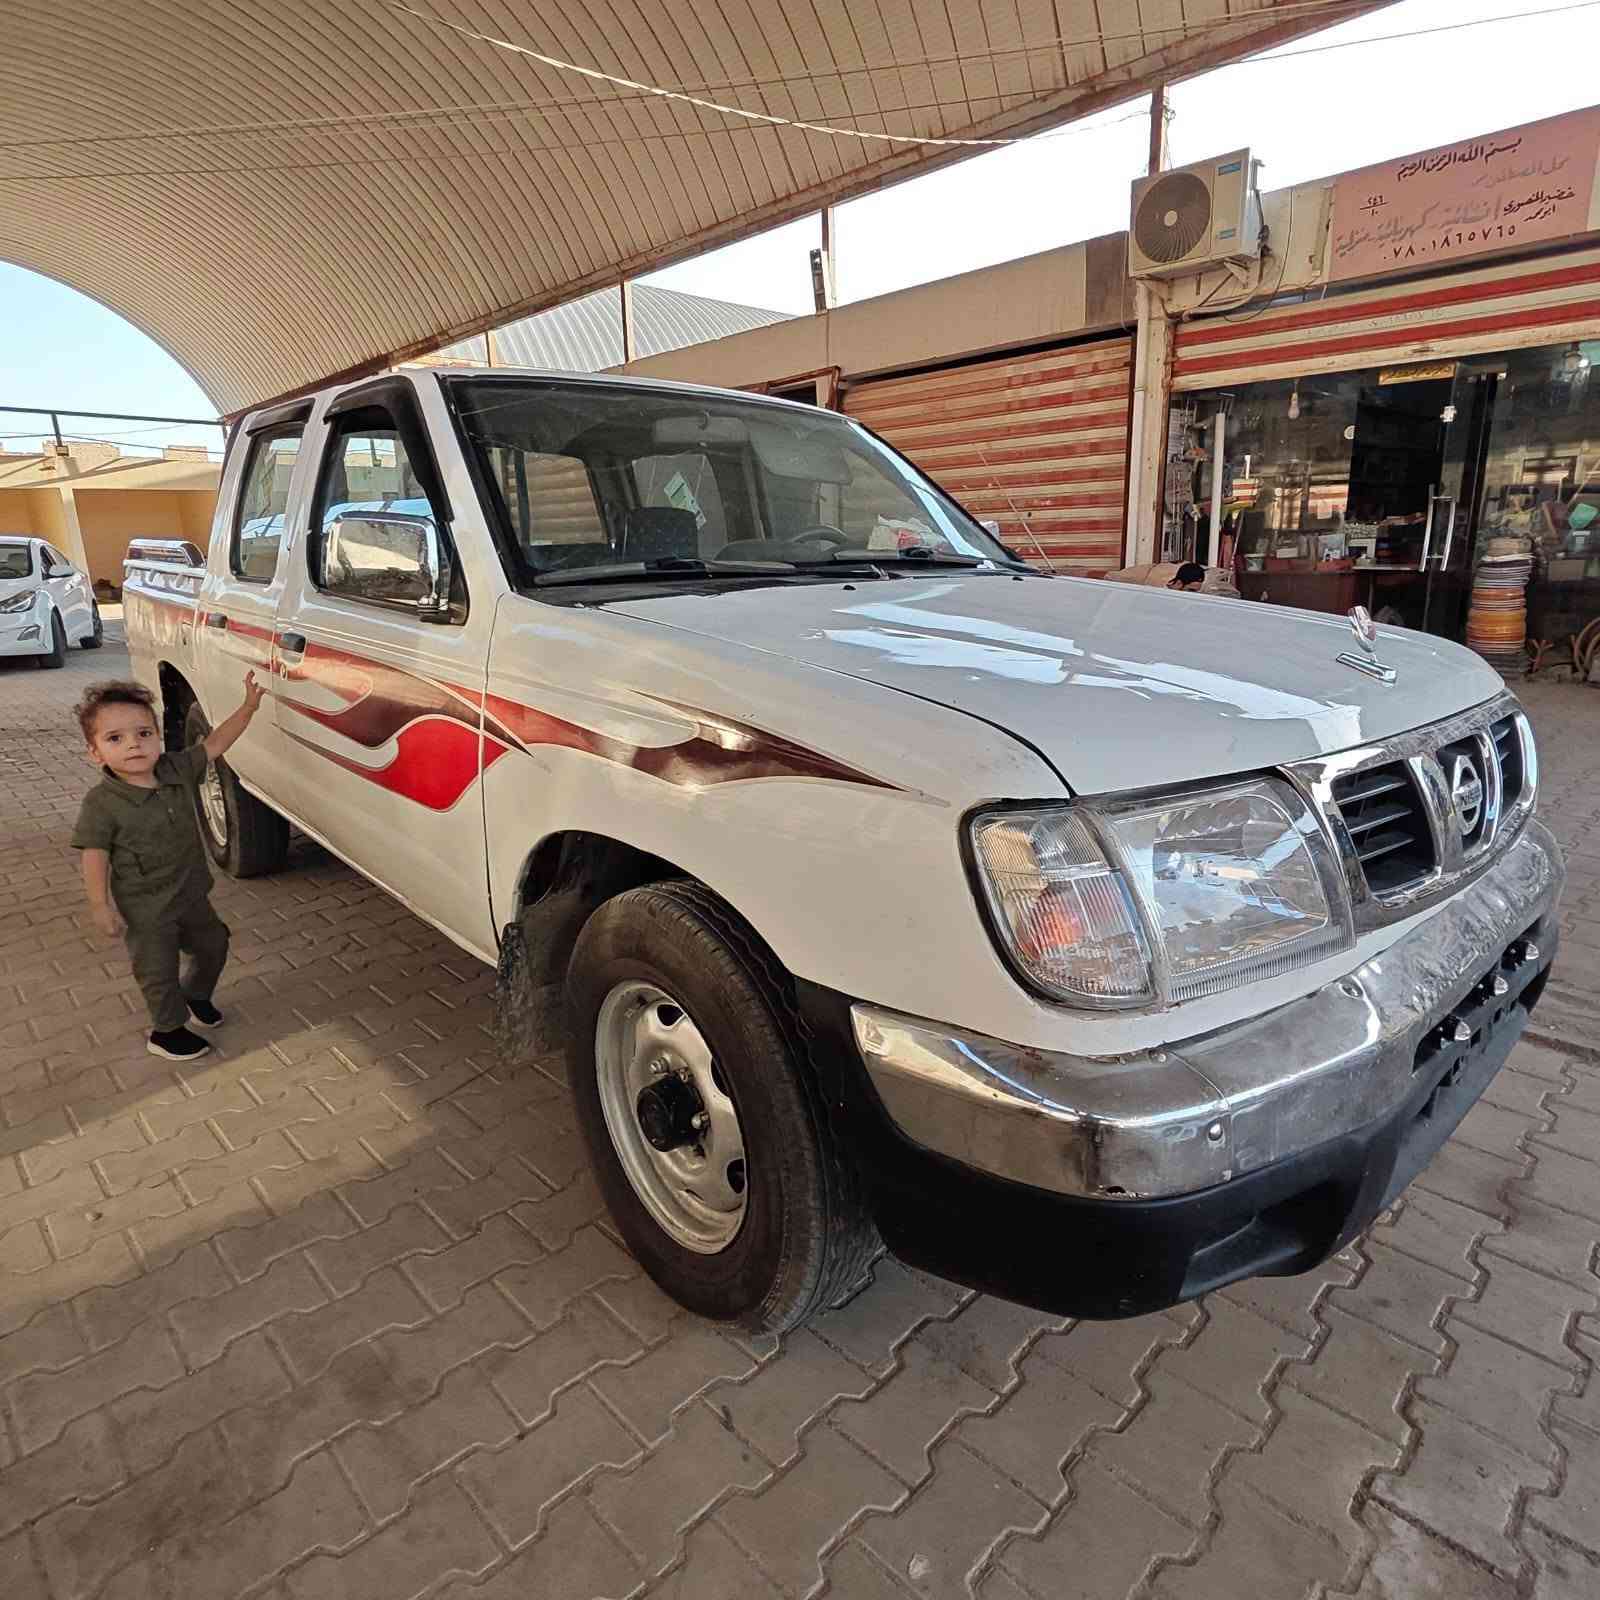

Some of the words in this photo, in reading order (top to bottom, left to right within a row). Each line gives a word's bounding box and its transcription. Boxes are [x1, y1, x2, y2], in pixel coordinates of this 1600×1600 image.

[1425, 151, 1457, 173] الرحمن
[1458, 144, 1484, 163] الله
[1484, 137, 1522, 165] بسم
[1397, 159, 1426, 182] الرحيم
